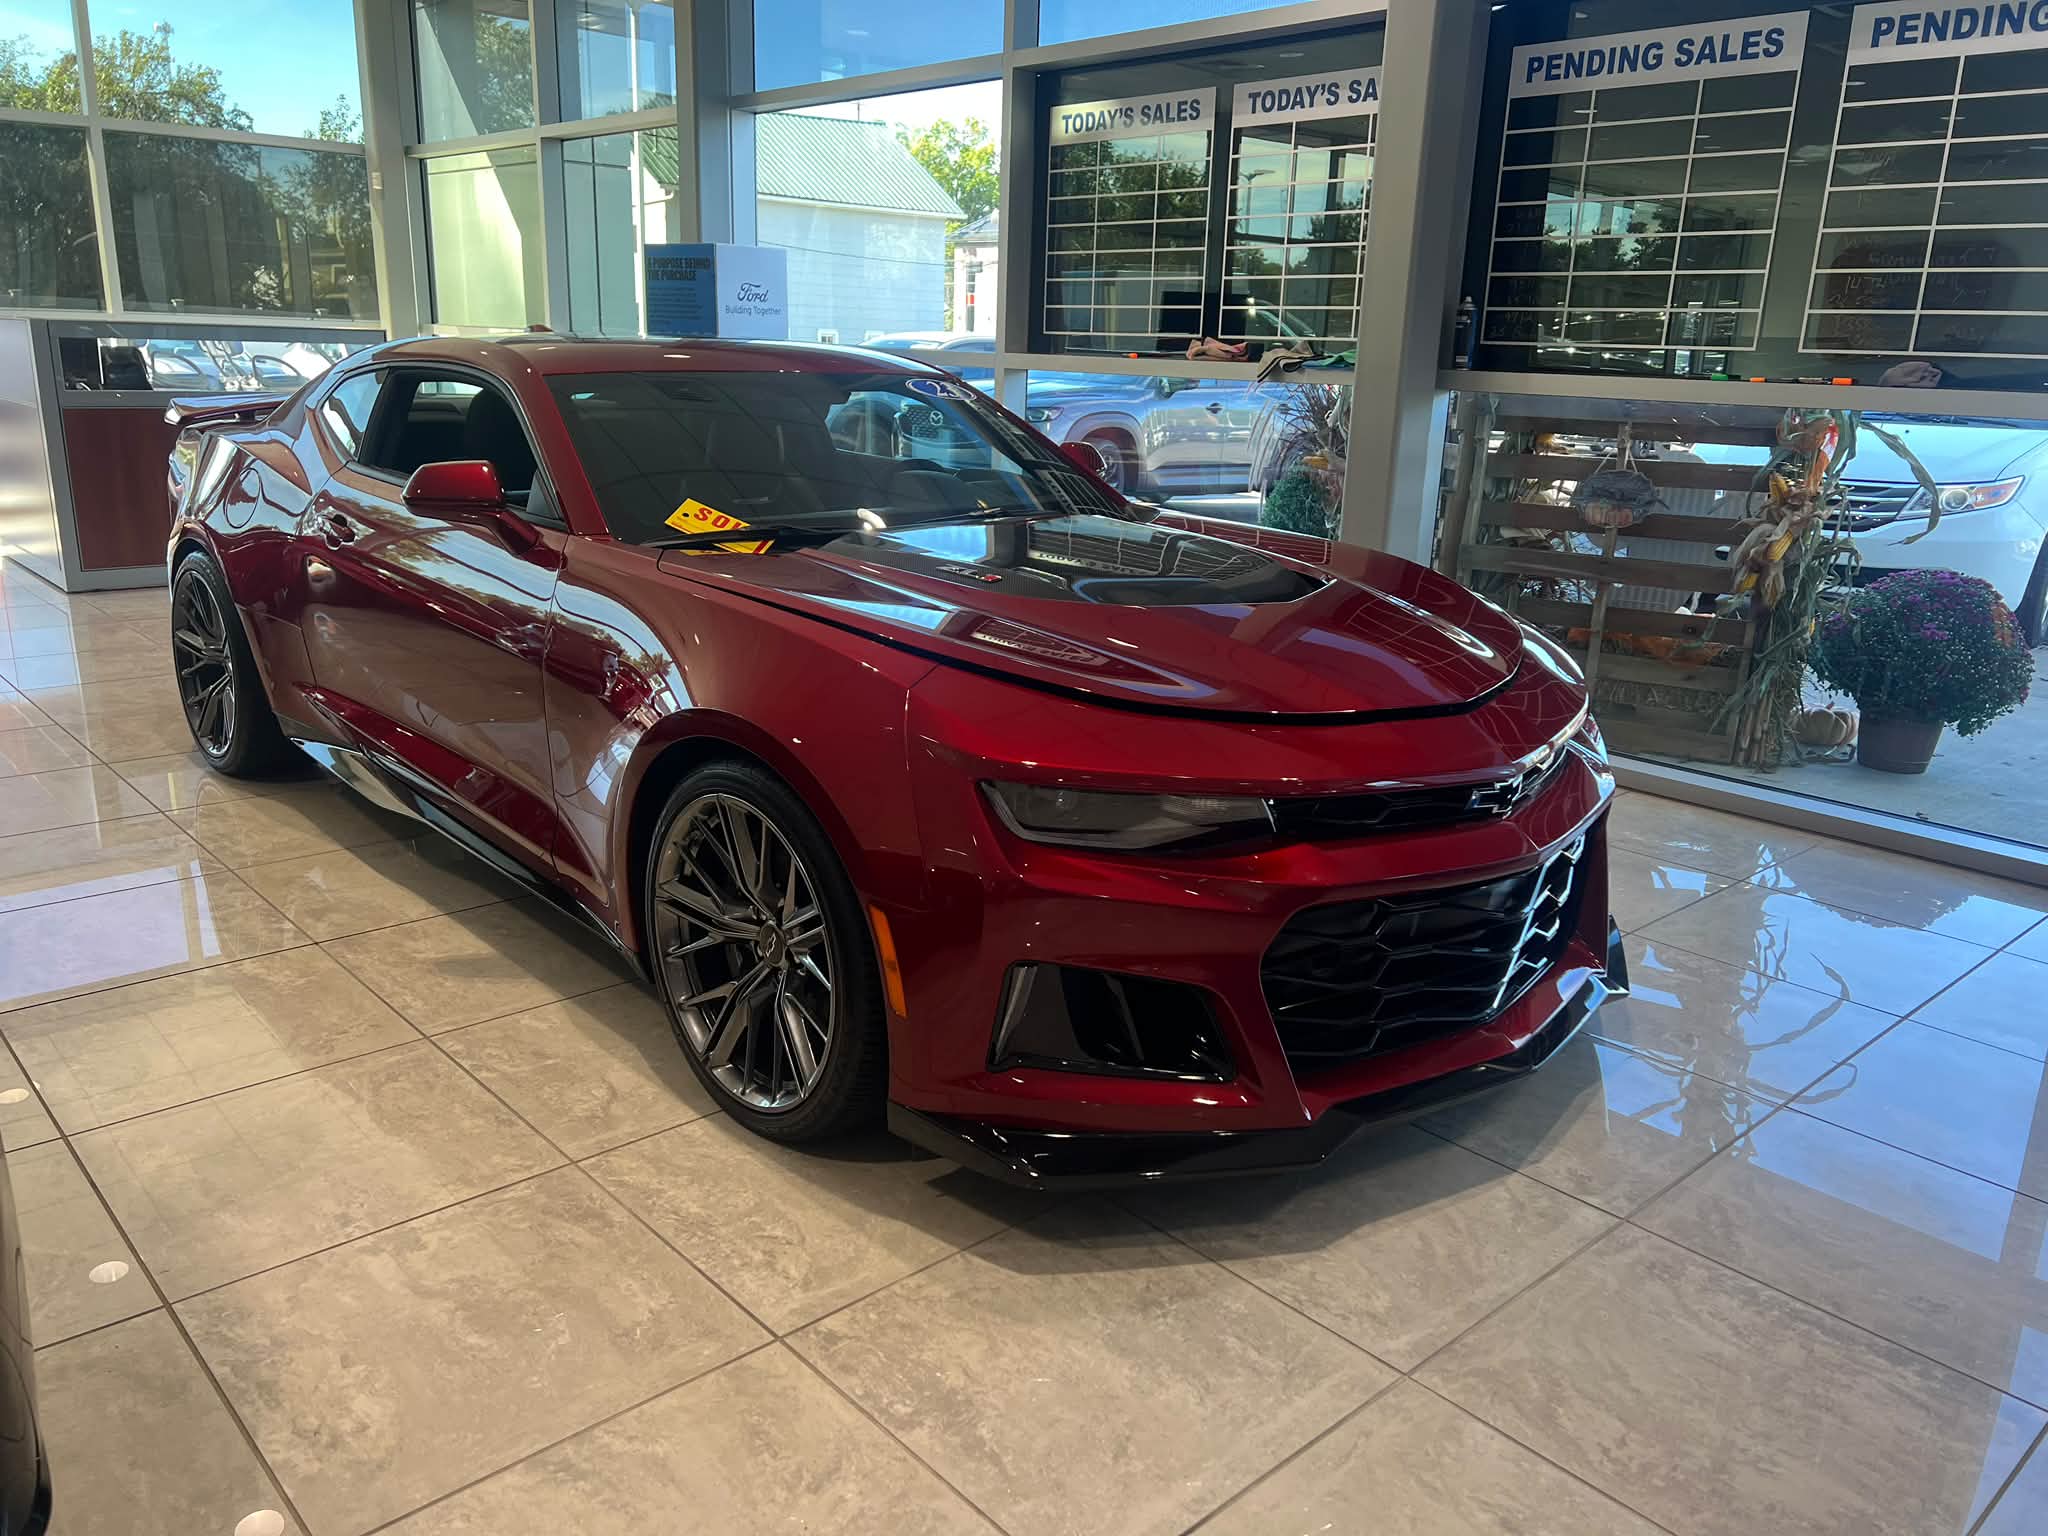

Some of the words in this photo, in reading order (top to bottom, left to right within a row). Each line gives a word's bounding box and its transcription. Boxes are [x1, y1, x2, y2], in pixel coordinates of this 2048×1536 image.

[1871, 0, 2048, 48] PENDING
[1526, 41, 1664, 83] PENDING
[1674, 27, 1785, 67] SALES
[1248, 82, 1340, 114] TODAY'S
[1062, 106, 1134, 134] TODAY'S
[1140, 98, 1201, 126] SALES
[737, 282, 769, 302] Ford
[725, 305, 752, 316] Building
[753, 305, 781, 316] Together
